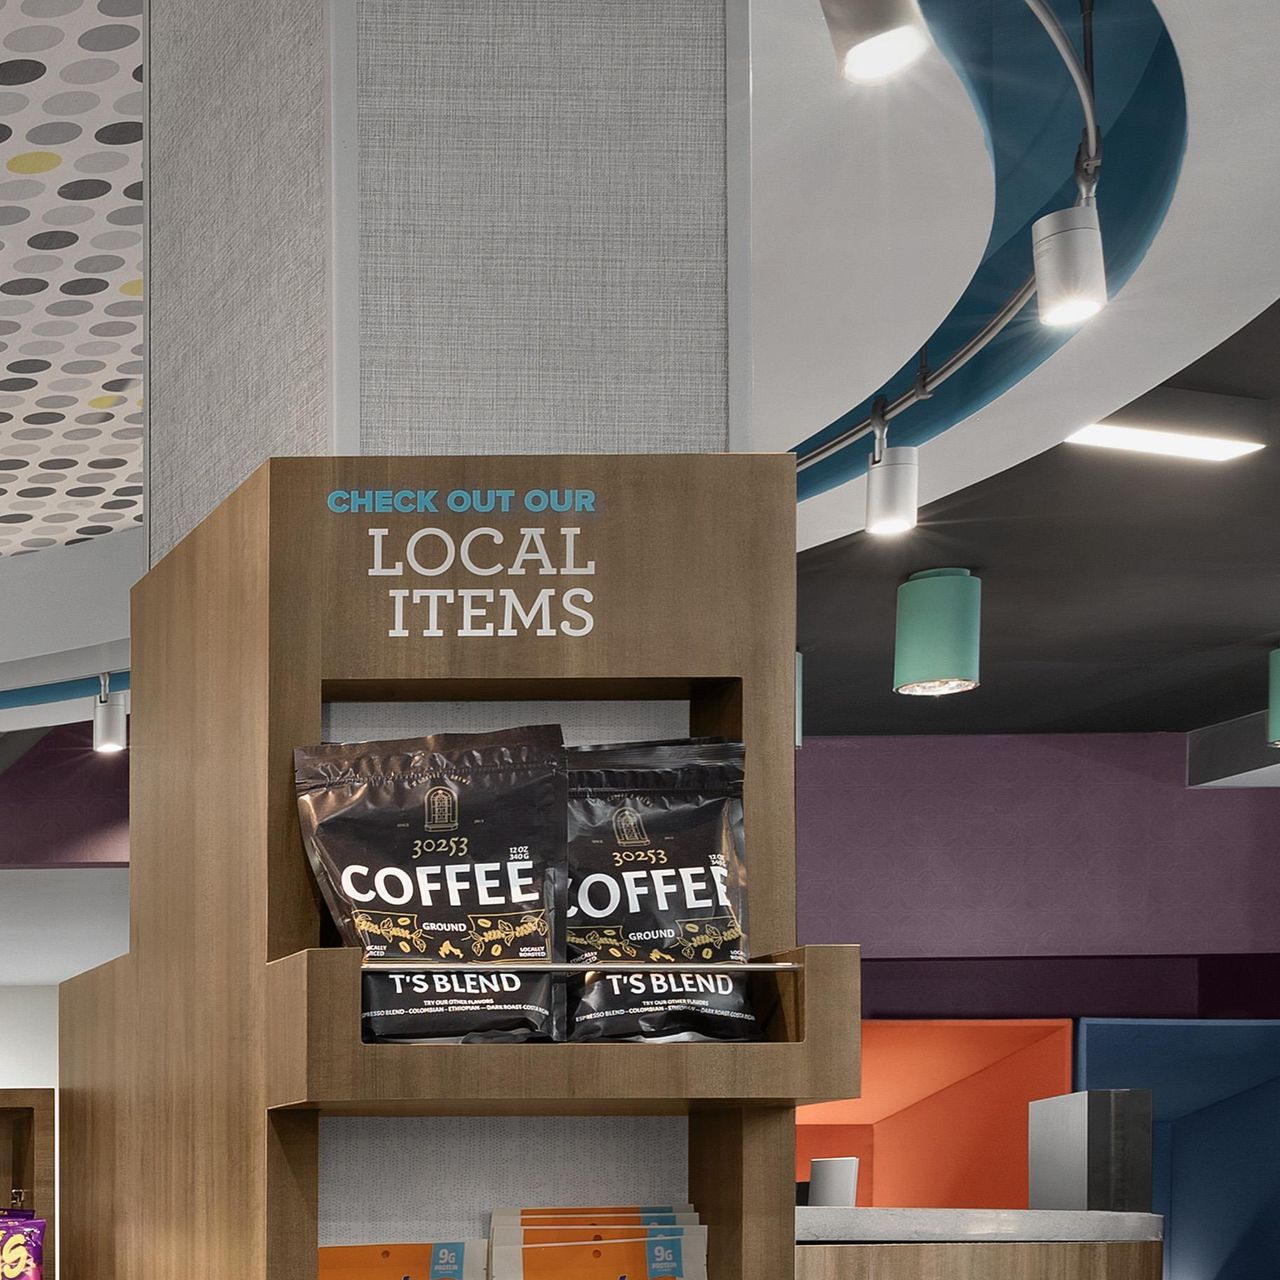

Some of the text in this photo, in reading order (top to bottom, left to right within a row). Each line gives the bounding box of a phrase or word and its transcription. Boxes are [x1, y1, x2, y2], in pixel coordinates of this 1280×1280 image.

[327, 489, 596, 513] CHECK OUT OUR
[368, 526, 596, 577] LOCAL
[388, 587, 595, 637] ITEMS
[412, 837, 469, 859] 30253
[612, 850, 668, 867] 30253
[341, 860, 540, 907] COFFEE
[422, 921, 468, 933] GROUND
[628, 929, 675, 941] GROUND
[388, 973, 521, 994] T'S BLEND
[606, 973, 734, 996] T'S BLEND
[439, 1248, 456, 1264] 9G
[654, 1245, 673, 1262] 9G
